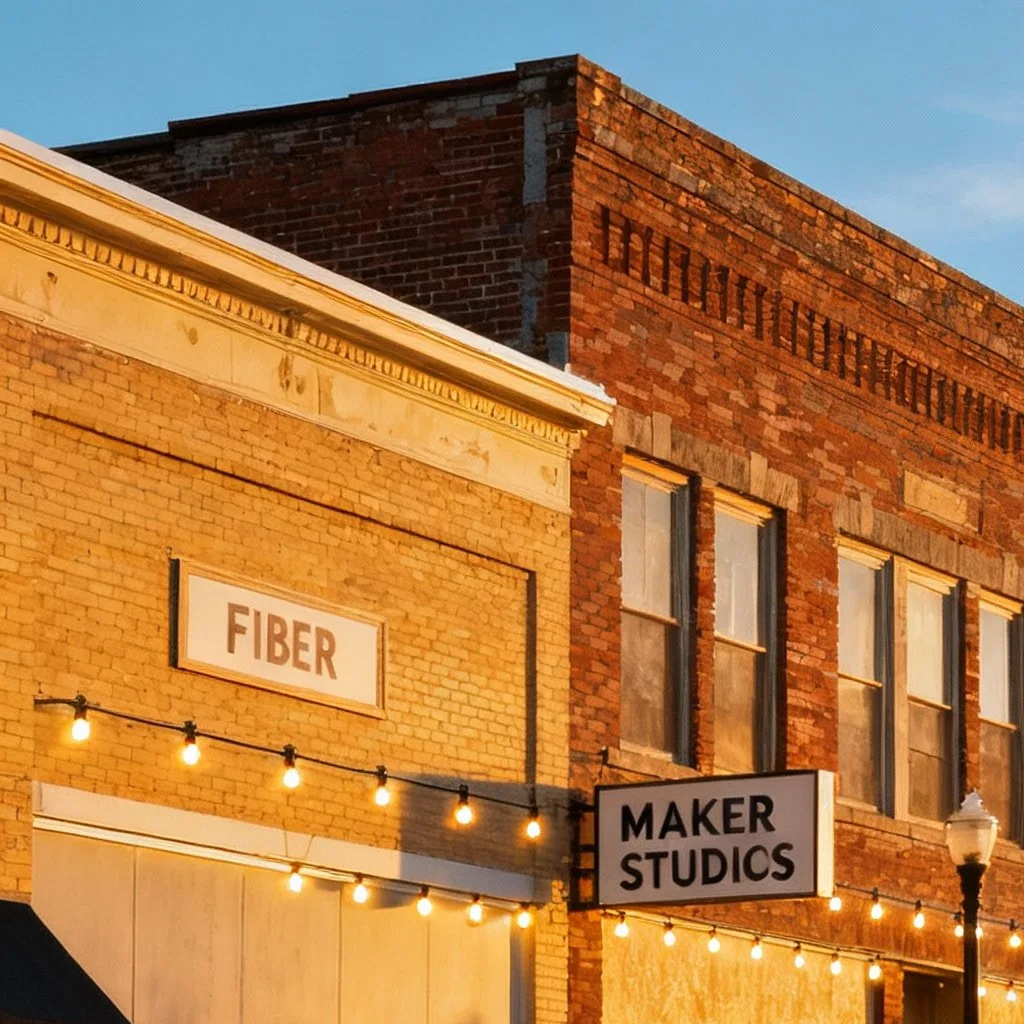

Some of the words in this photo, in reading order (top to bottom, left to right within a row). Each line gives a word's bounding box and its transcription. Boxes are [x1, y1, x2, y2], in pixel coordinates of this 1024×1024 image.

[227, 602, 337, 680] FIBER
[621, 795, 776, 842] MAKER
[619, 842, 795, 891] STUDIOS
